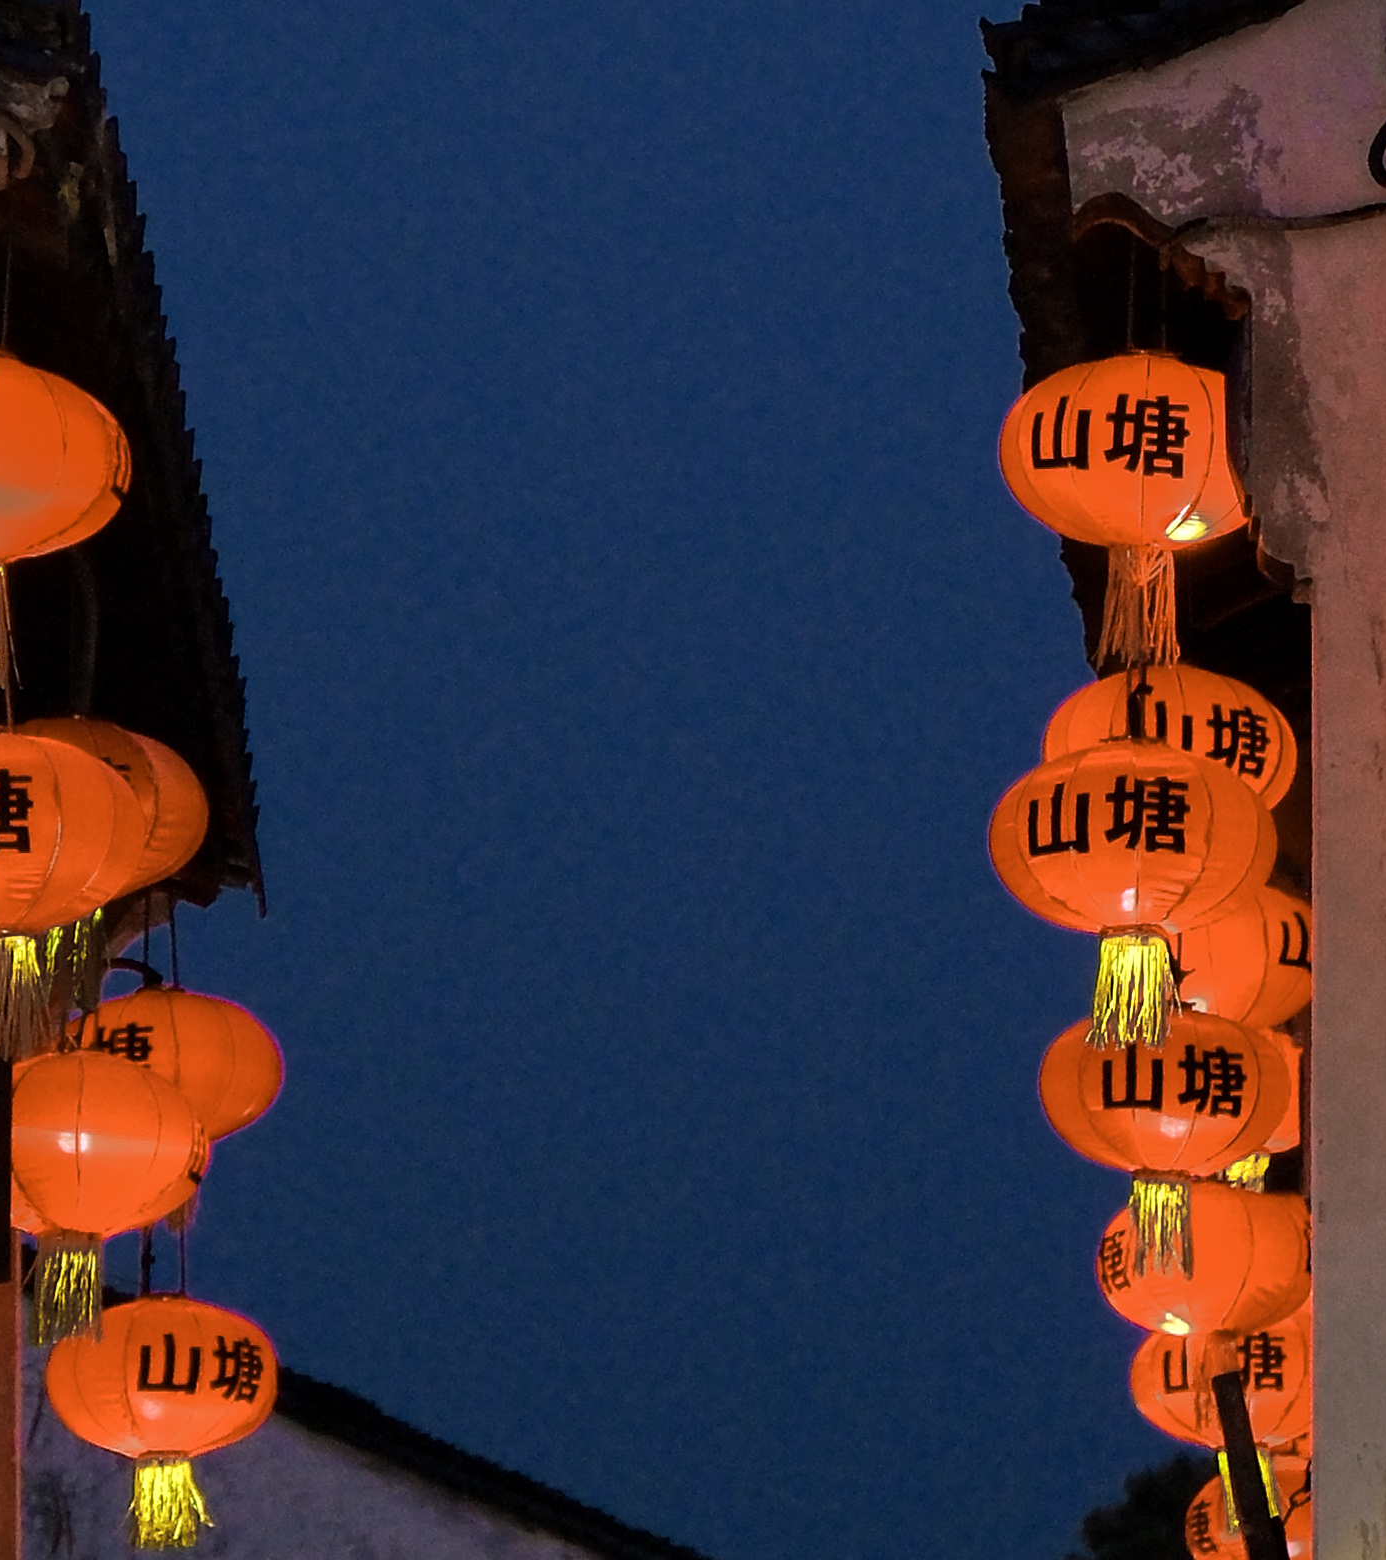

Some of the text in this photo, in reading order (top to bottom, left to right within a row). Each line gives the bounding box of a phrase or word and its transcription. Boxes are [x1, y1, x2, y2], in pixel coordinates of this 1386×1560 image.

[1031, 393, 1190, 479] 山塘
[1027, 775, 1191, 856] 山塘
[1102, 1044, 1248, 1119] 山塘
[137, 1333, 264, 1404] 山塘
